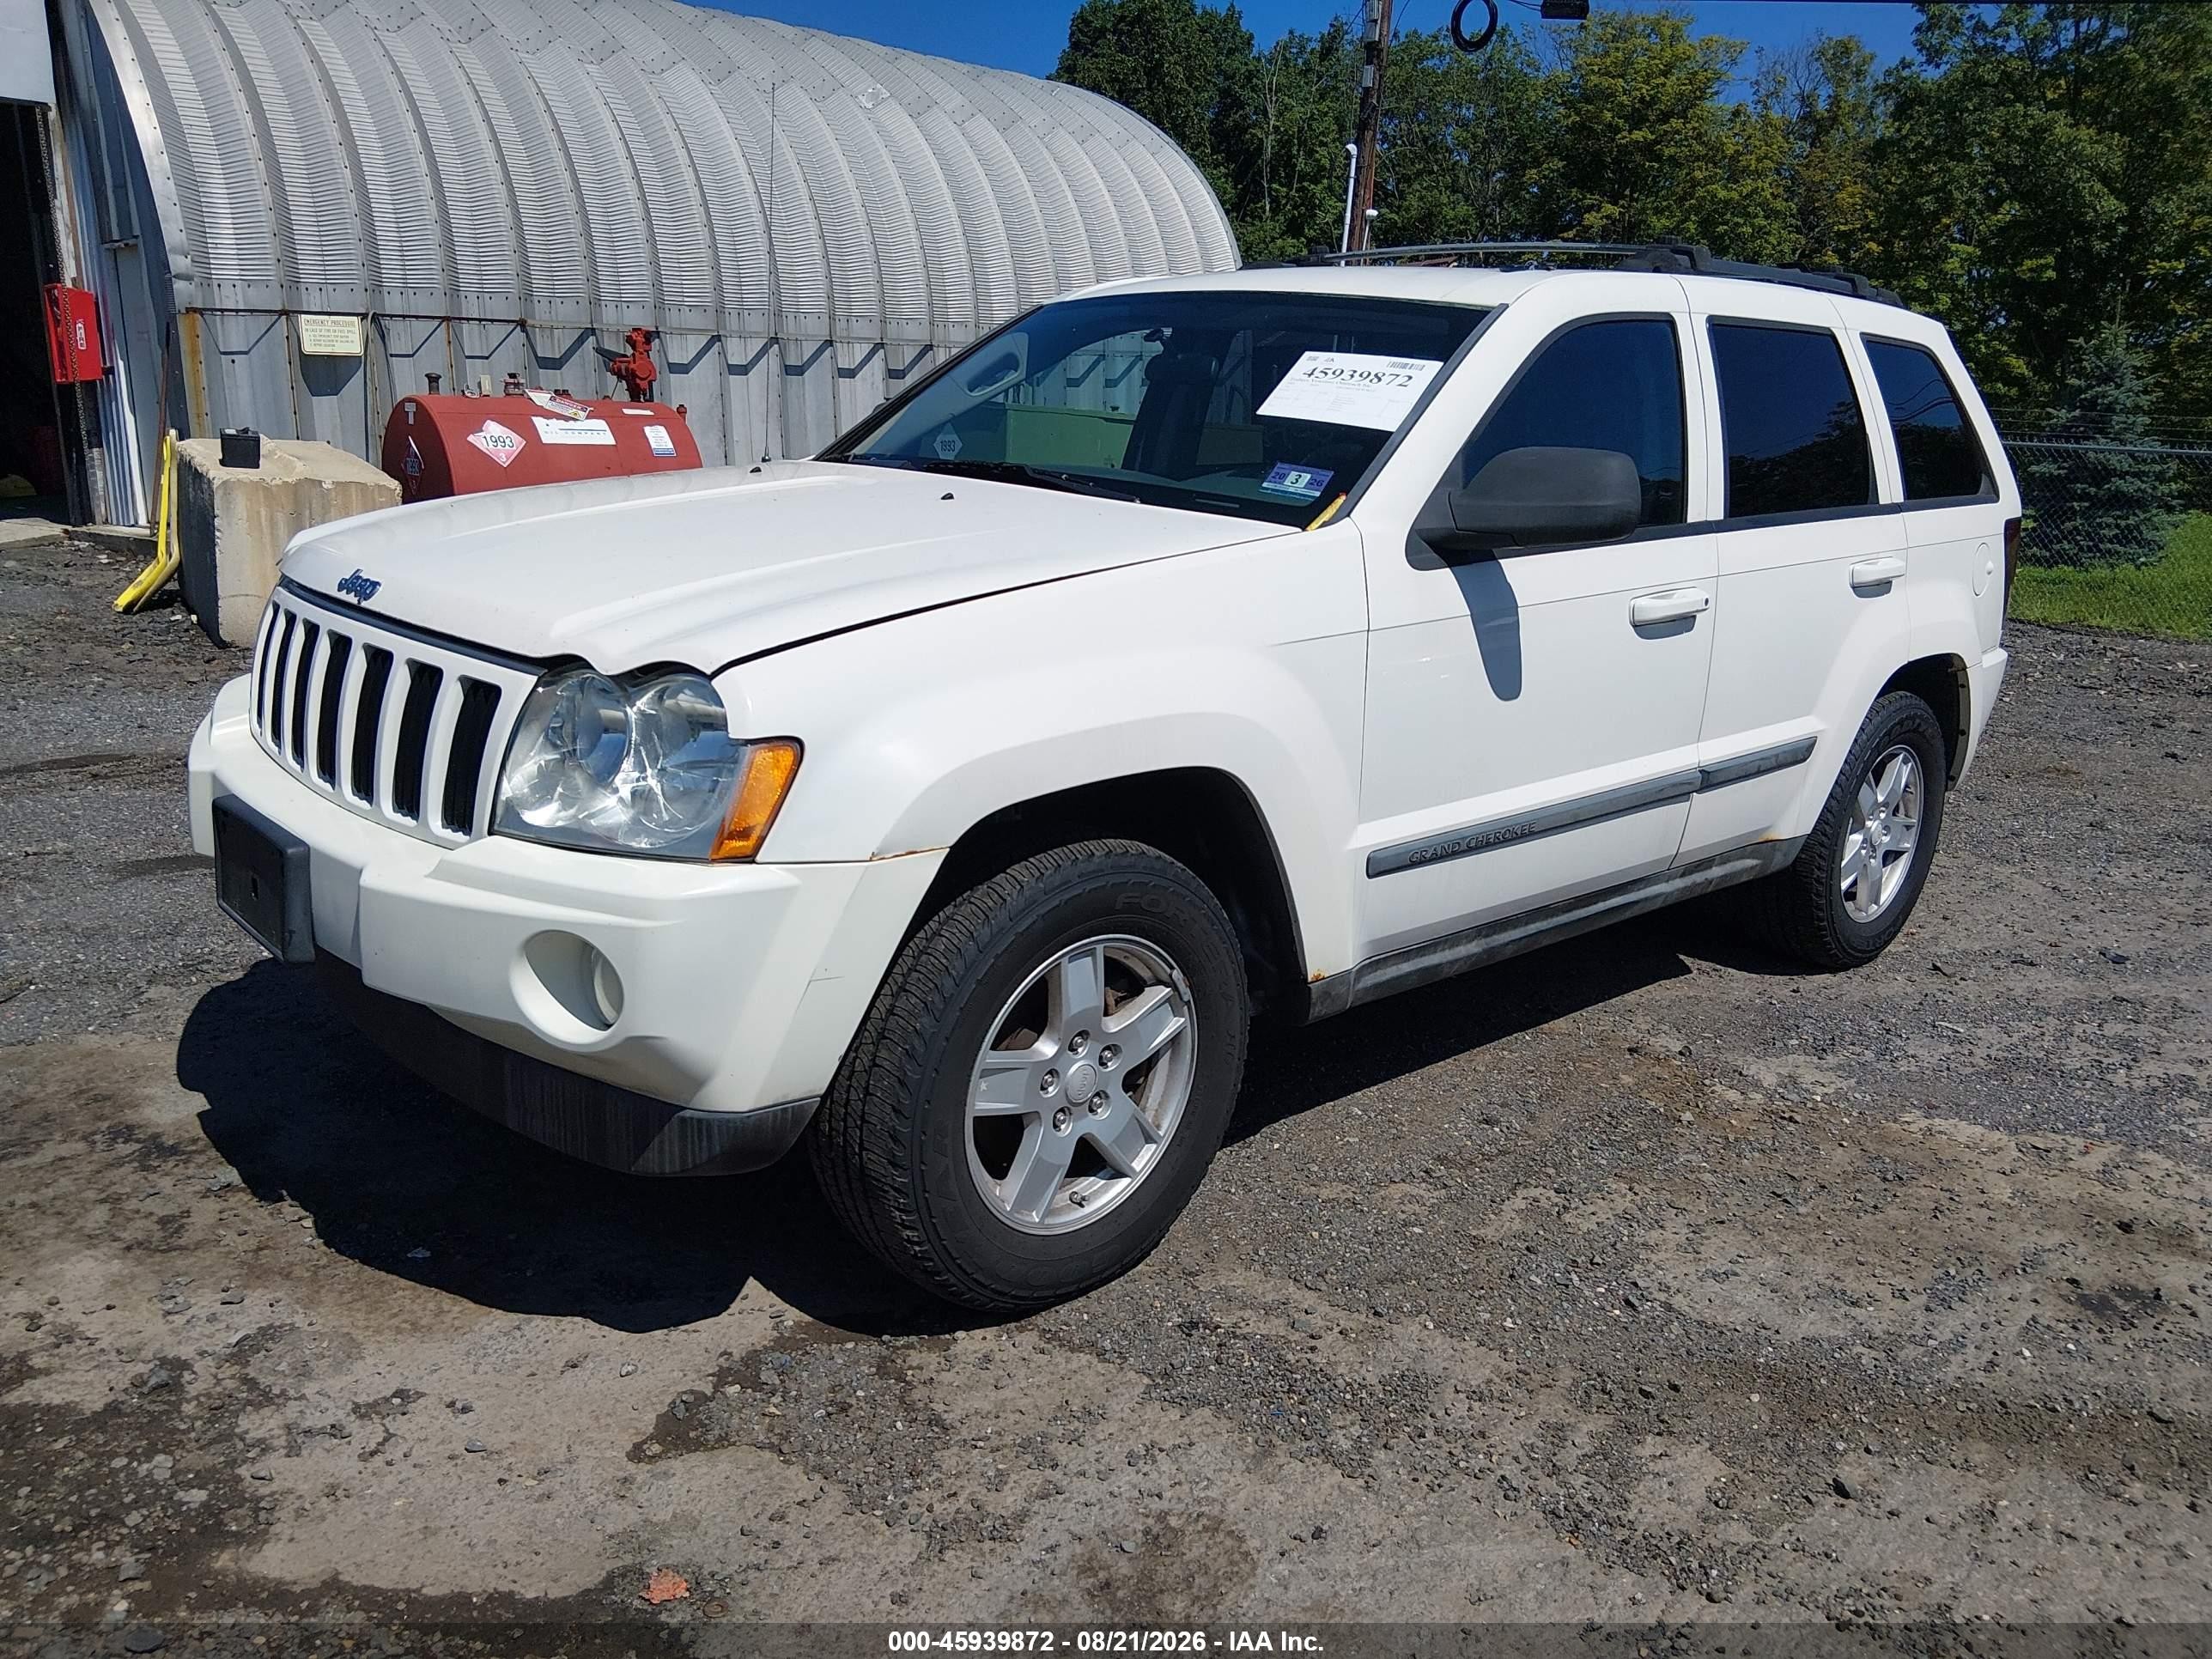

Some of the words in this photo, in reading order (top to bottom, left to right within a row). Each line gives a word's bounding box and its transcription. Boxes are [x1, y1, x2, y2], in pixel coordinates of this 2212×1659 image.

[1302, 367, 1413, 387] 45939872
[556, 398, 581, 410] DANGER
[483, 434, 514, 448] 1993
[939, 440, 956, 453] 1993
[499, 453, 507, 462] 3
[1271, 471, 1285, 481] 20
[1291, 473, 1302, 484] 3
[1309, 478, 1325, 487] 26
[337, 568, 382, 605] Jeep
[1407, 840, 1462, 864] GRAND
[1465, 821, 1538, 848] CHEROKEE
